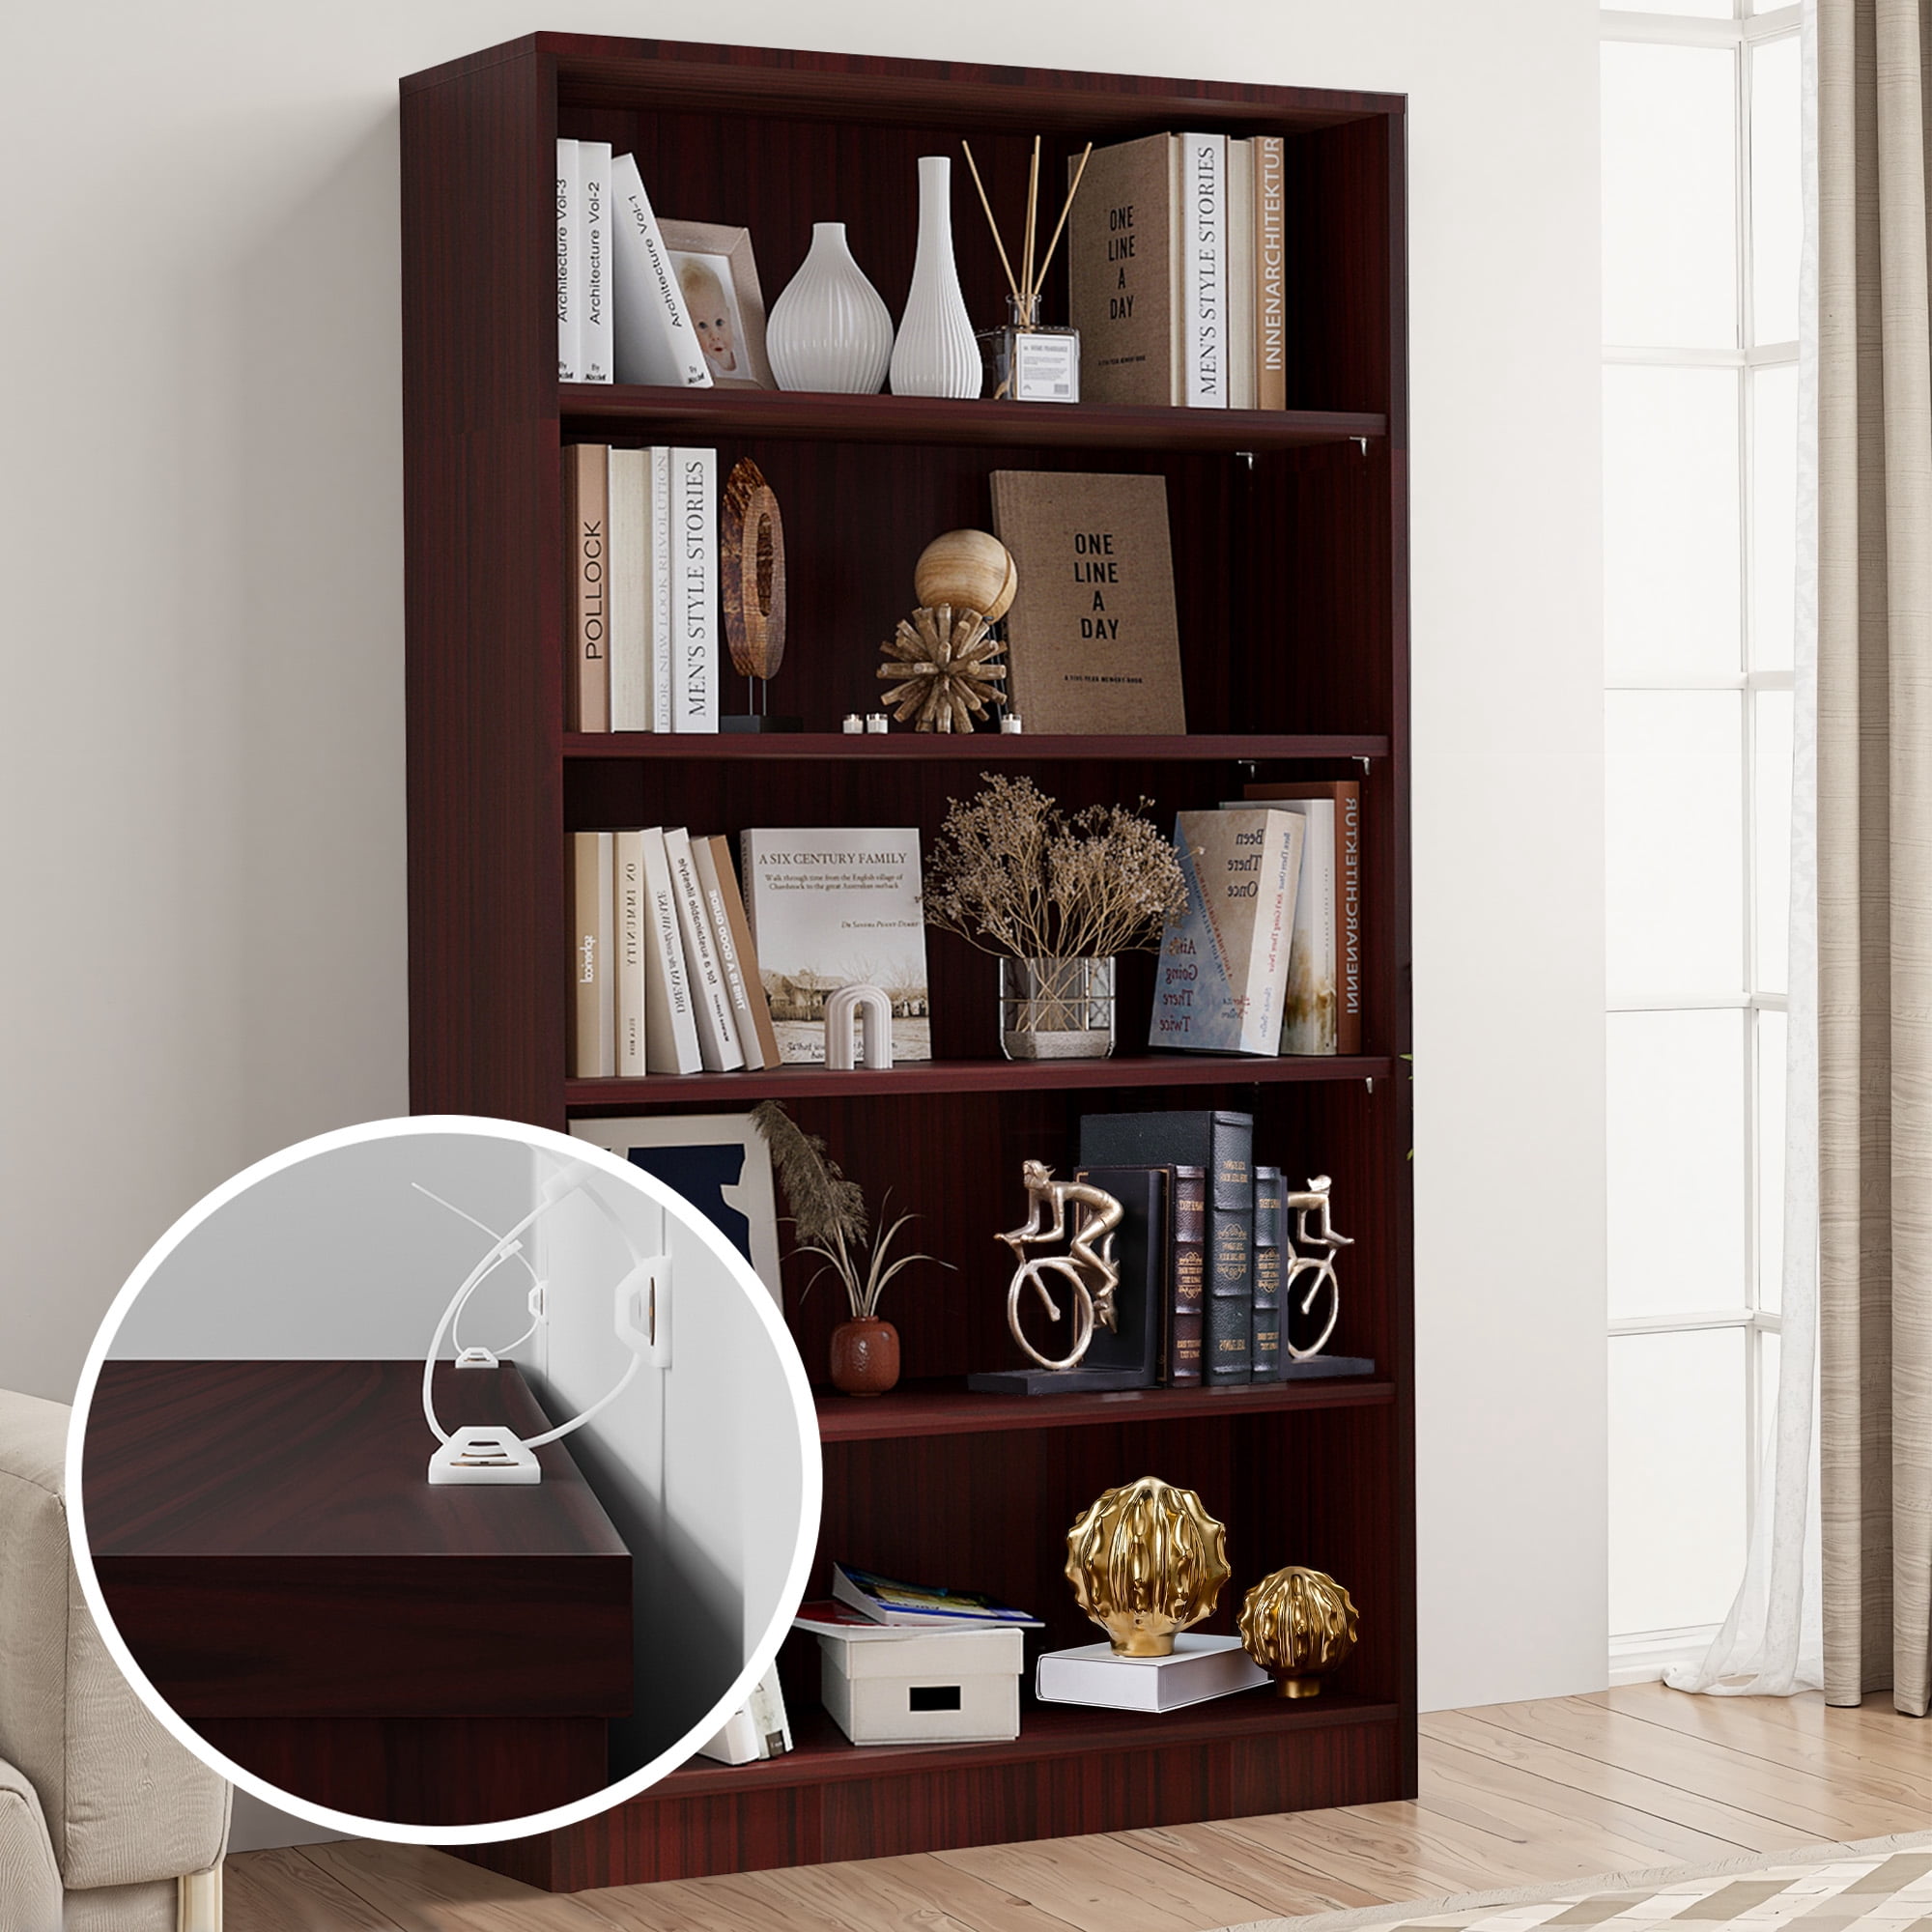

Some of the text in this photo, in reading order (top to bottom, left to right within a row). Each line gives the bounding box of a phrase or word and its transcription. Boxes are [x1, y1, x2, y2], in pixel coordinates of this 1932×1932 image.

[1110, 206, 1135, 231] ONE
[556, 179, 568, 323] Architecture Vol-3
[588, 182, 601, 326] Architecture Vol-2
[628, 195, 682, 327] Architecture Vol-1
[1108, 235, 1135, 262] LINE
[1264, 137, 1283, 370] INNENARCHITEKTUR
[1118, 268, 1126, 289] A
[1198, 147, 1217, 395] MEN'S STYLE STORIES
[1111, 296, 1135, 320] DAY
[657, 456, 668, 571] REVOLUTION
[1075, 533, 1114, 554] ONE
[583, 521, 603, 660] POLLOCK
[686, 461, 706, 717] MEN'S STYLE STORIES
[1074, 562, 1119, 583] LINE
[658, 578, 668, 626] LOOK
[1093, 590, 1105, 611] A
[1081, 618, 1119, 639] DAY
[659, 634, 668, 673] NEW
[758, 852, 907, 865] A SIX CENTURY FAMILY
